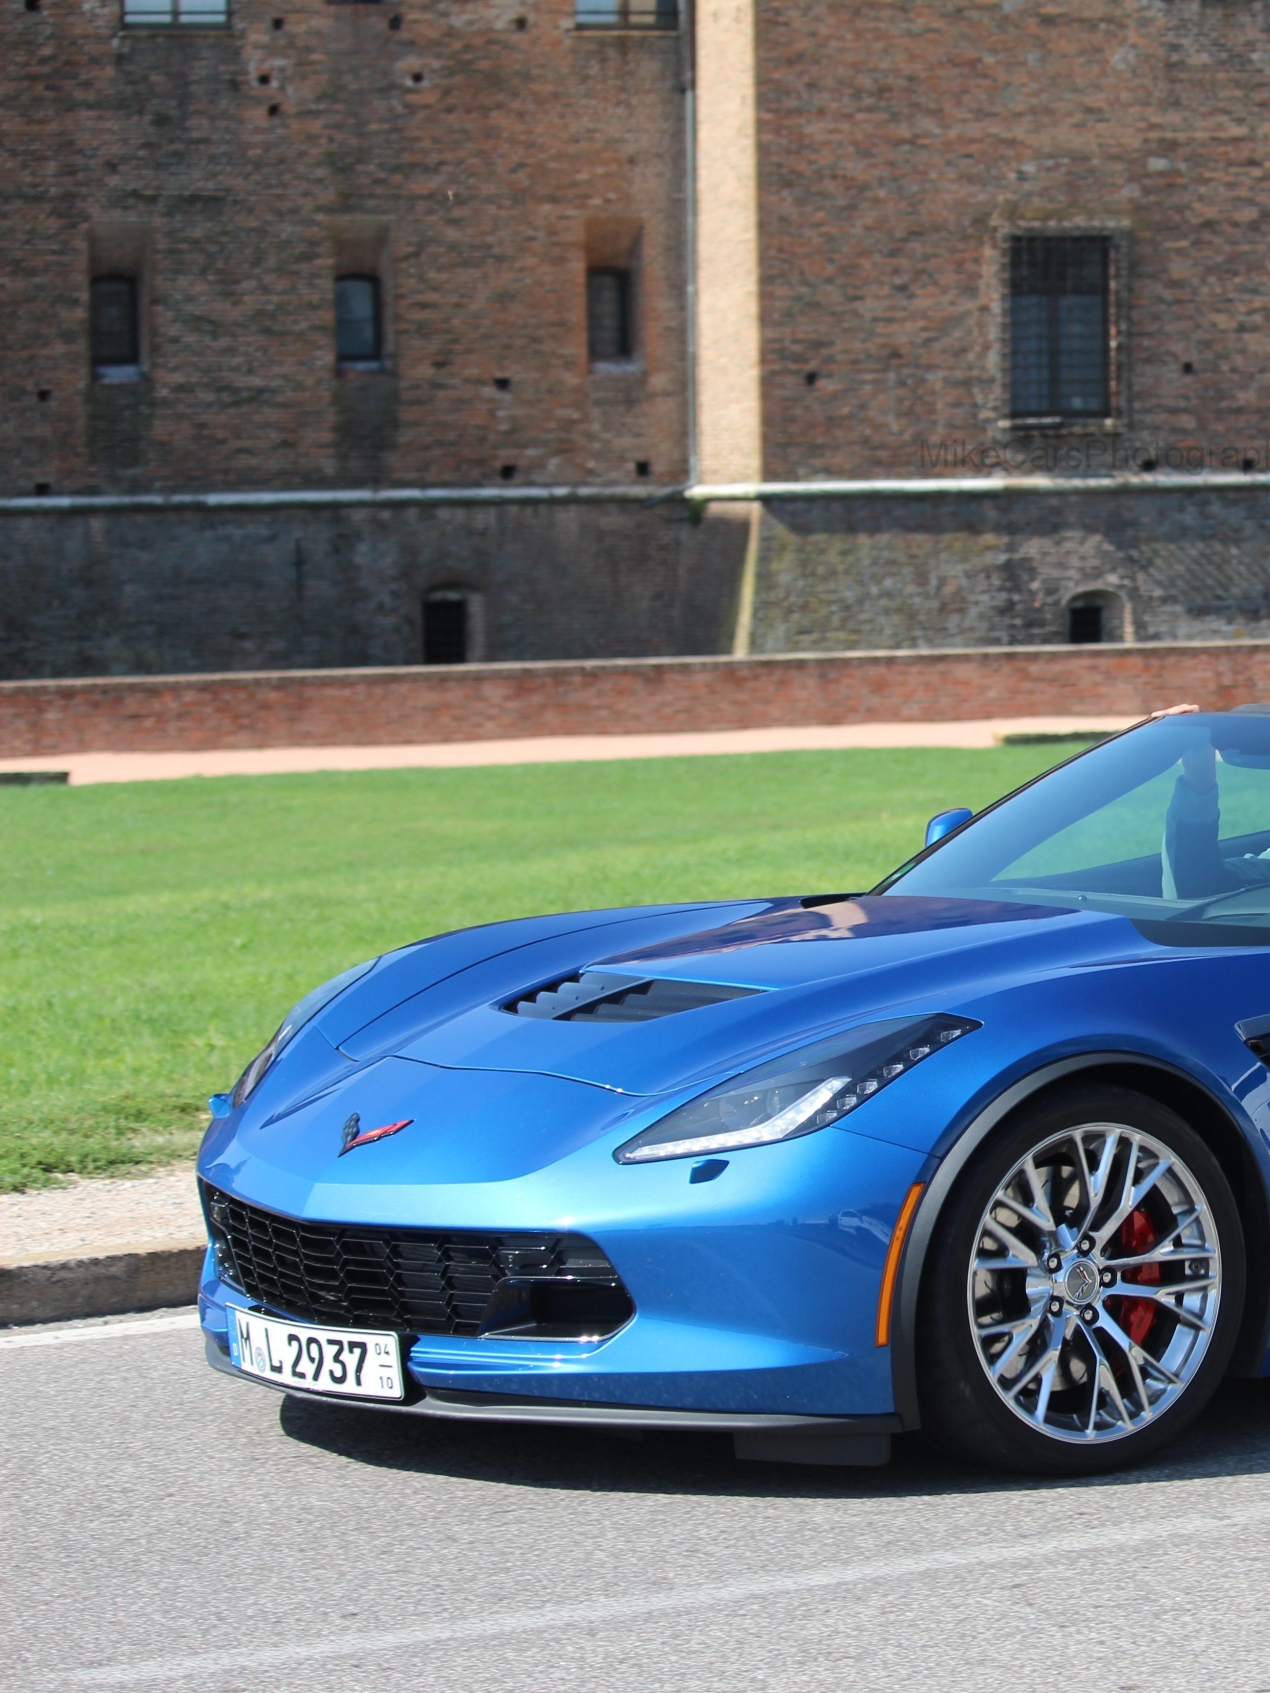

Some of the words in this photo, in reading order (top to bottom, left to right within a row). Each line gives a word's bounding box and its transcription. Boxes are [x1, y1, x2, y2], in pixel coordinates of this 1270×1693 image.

[374, 1342, 391, 1357] 04
[287, 1333, 367, 1387] 2937
[378, 1375, 394, 1390] 10
